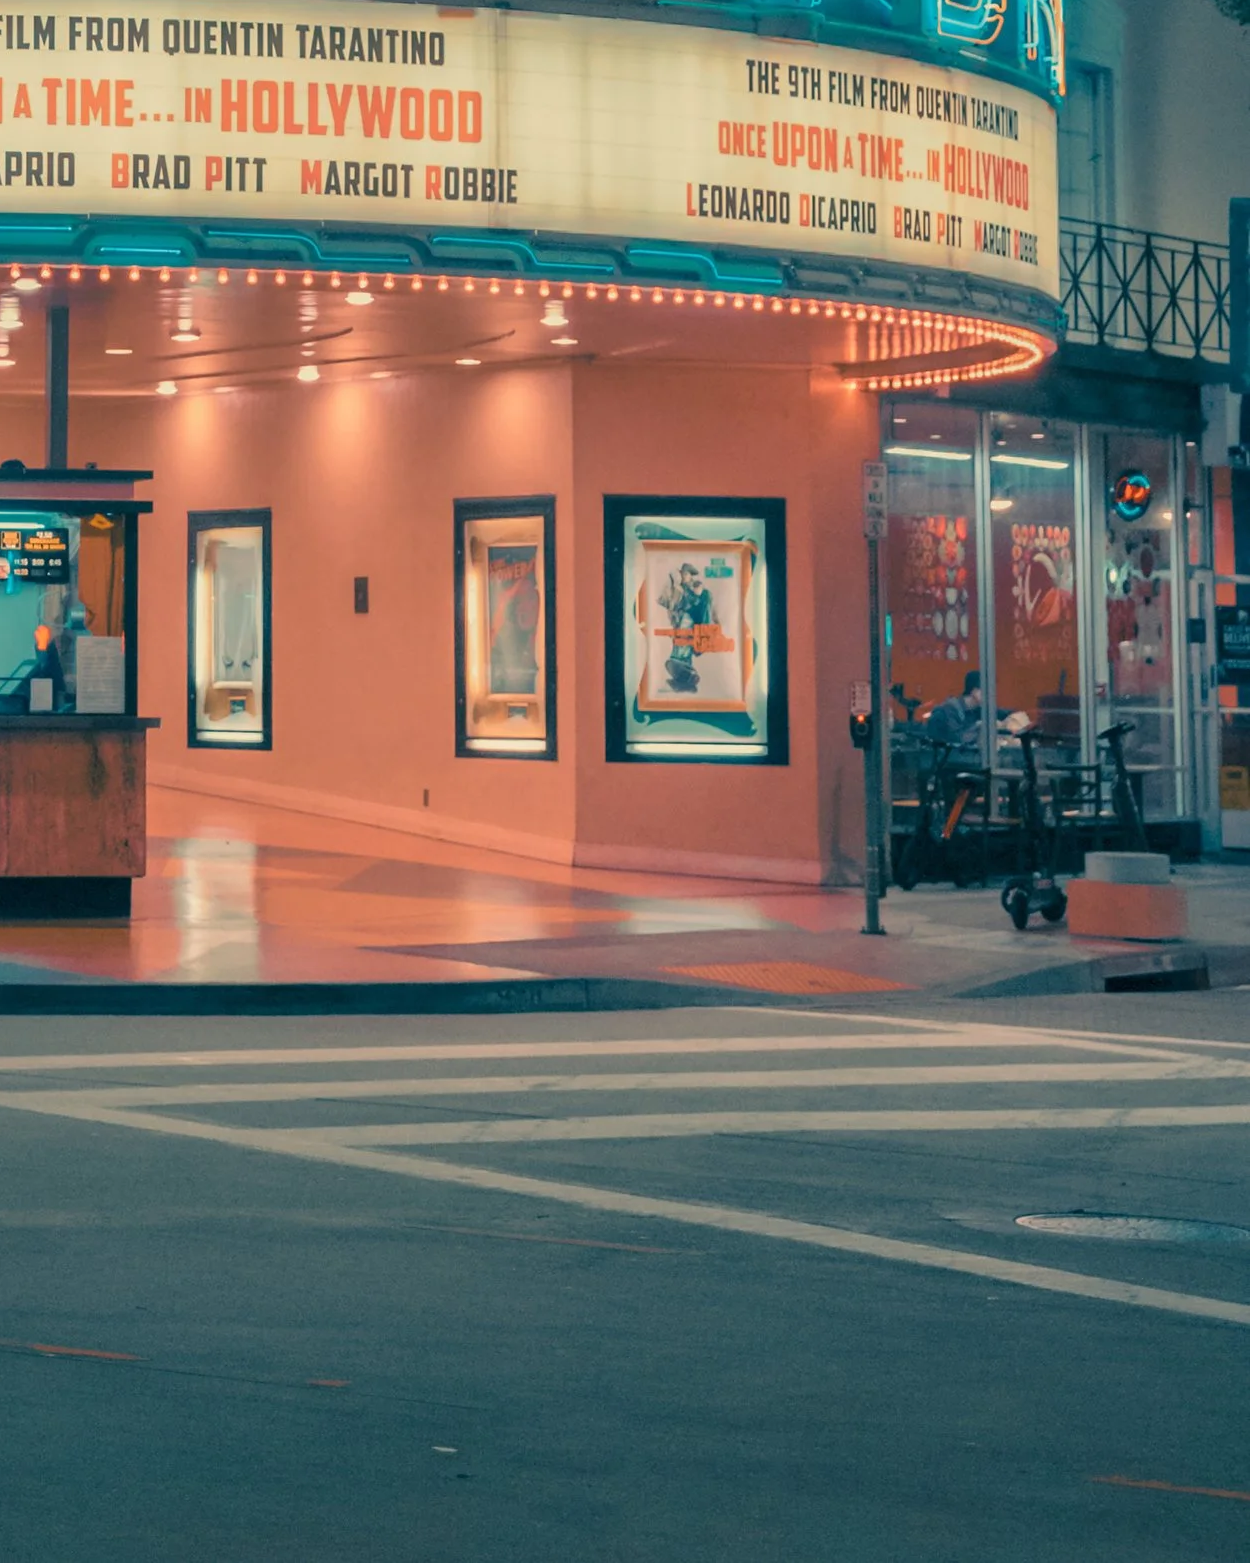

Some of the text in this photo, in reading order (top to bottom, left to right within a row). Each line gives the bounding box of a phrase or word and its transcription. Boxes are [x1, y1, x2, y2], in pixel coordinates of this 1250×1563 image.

[69, 16, 150, 53] FROM
[163, 18, 284, 57] QUENTIN
[296, 24, 445, 66] TARANTINO
[13, 83, 32, 119] A
[41, 78, 175, 127] TIME...
[184, 87, 212, 123] IN
[221, 78, 482, 144] HOLLYWOOD
[747, 59, 1018, 141] THE 9TH FILM FROM QUENTIN TARANTINO
[111, 153, 191, 189] BRAD
[205, 156, 267, 192] PITT
[301, 159, 414, 198] MARGOT
[425, 165, 518, 203] ROBBIE
[718, 120, 1029, 211] ONCE UPON A TIME... IN HOLLYWOOD
[686, 183, 1038, 266] LEONARDO DICAPRIO BRAD PITT MARGOT ROBBIE
